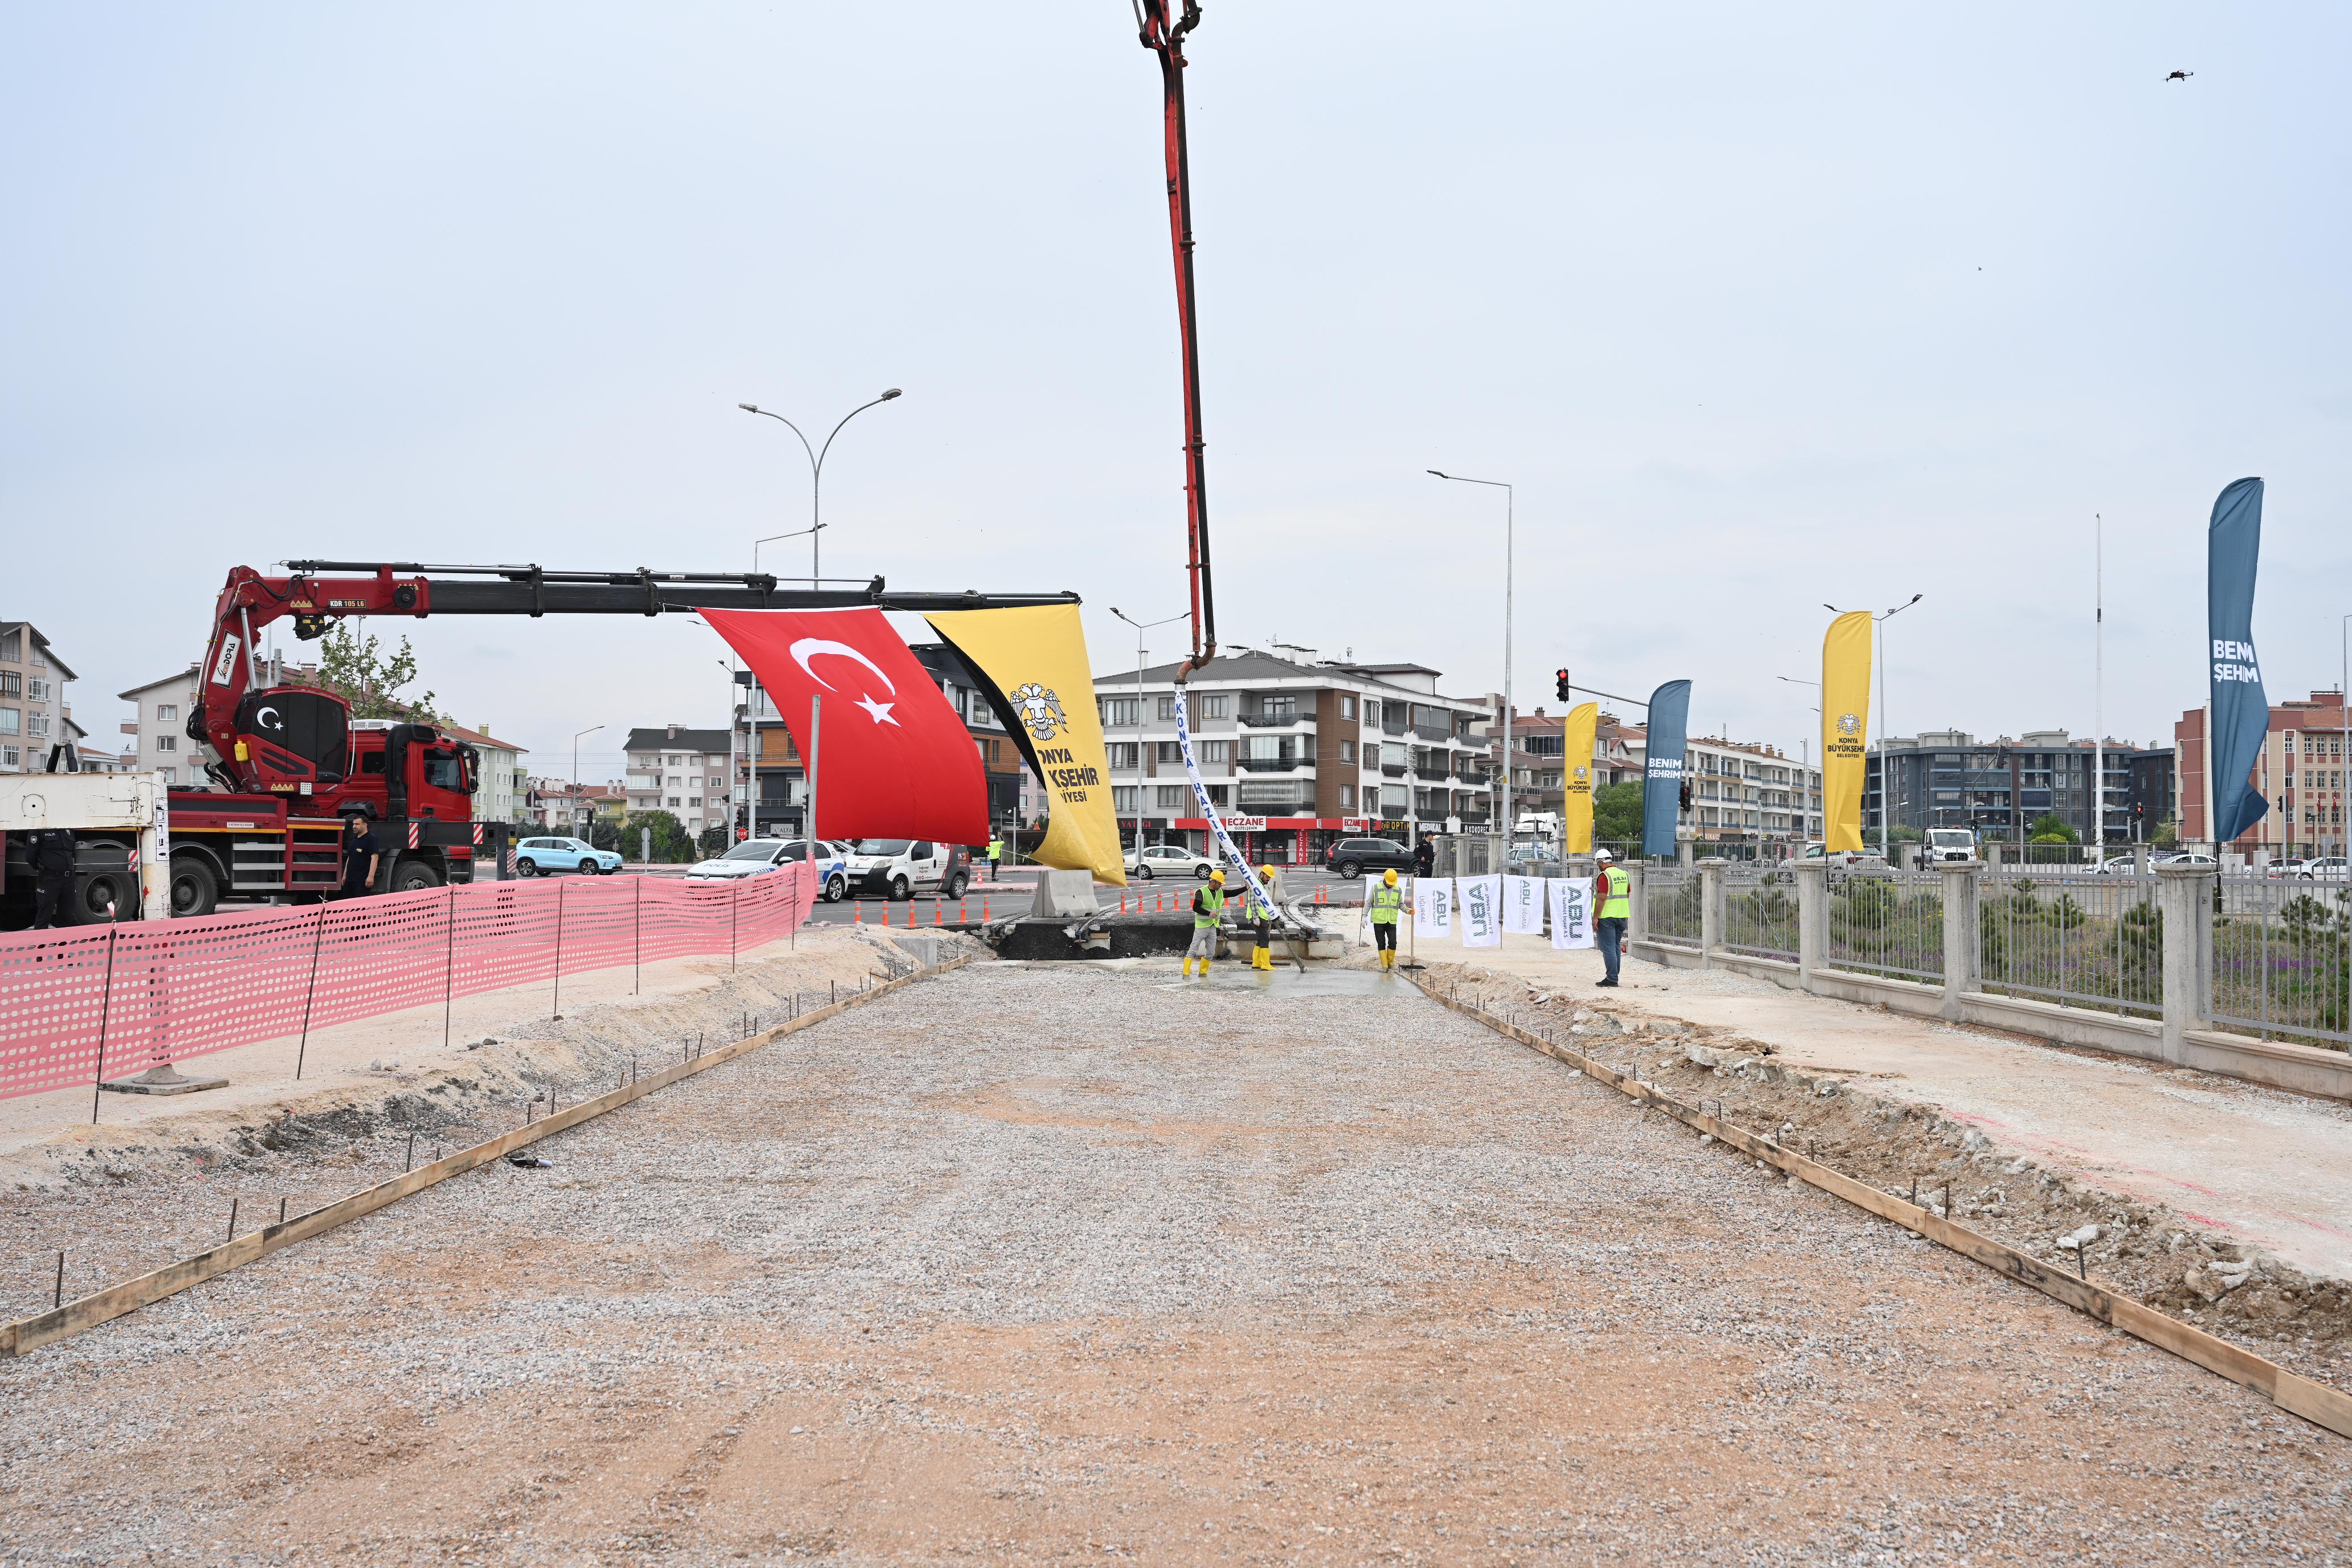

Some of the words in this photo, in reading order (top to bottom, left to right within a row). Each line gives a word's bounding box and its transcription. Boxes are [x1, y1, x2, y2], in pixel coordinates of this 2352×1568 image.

[1648, 769, 1681, 779] ŞEHRİM
[1649, 758, 1682, 769] BENİM
[1176, 703, 1194, 769] KONYA
[1194, 782, 1227, 842] HAZIR
[1231, 854, 1271, 908] BETON
[1227, 818, 1264, 826] ECZANE
[1522, 880, 1530, 905] ABU
[1436, 890, 1448, 926] ABU
[1567, 885, 1583, 939] ABU
